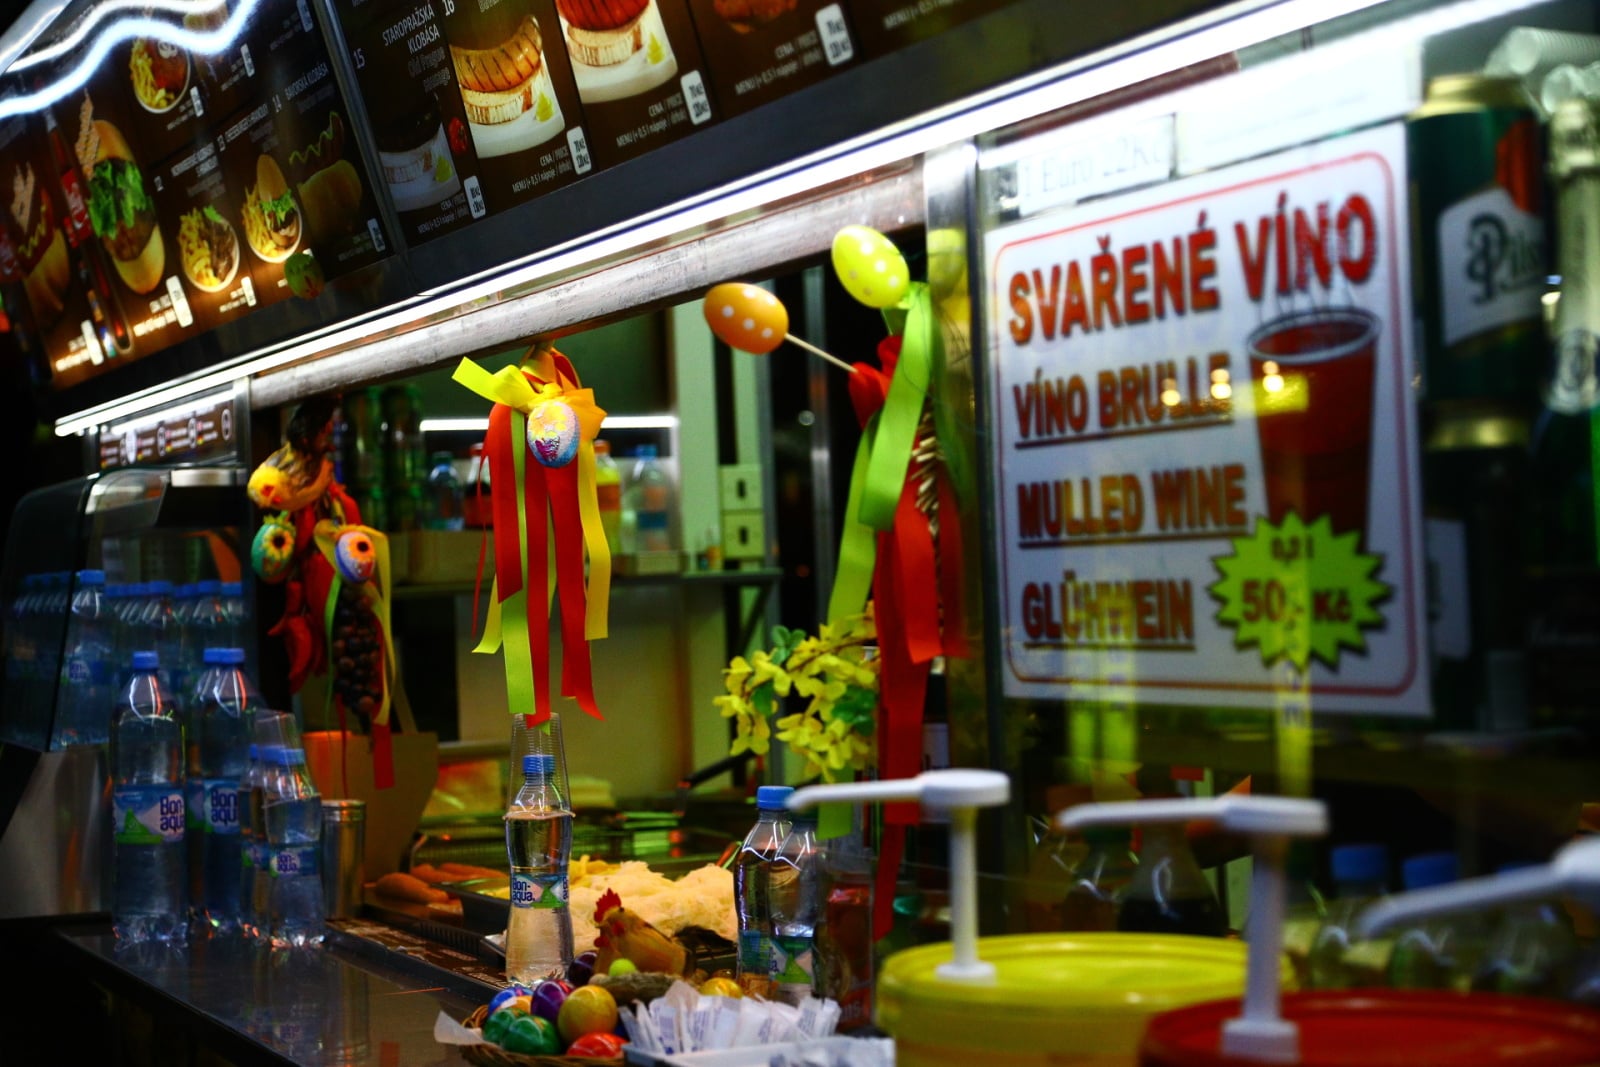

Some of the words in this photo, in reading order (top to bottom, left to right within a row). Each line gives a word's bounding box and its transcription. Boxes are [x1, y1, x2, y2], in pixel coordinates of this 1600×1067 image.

[382, 0, 435, 47] STAROPRAŽSKÁ
[407, 23, 441, 55] KLOBÁSA
[353, 47, 366, 69] 15
[1008, 209, 1221, 347] SVAŘENÉ
[1233, 190, 1378, 304] VÍNO
[1013, 366, 1089, 439] VÍNO
[1097, 352, 1233, 429] BRULLE
[1018, 472, 1145, 540] MULLED
[1150, 462, 1248, 531] WINE
[1021, 570, 1195, 641] GLÜHWEIN
[1313, 589, 1352, 623] Kč
